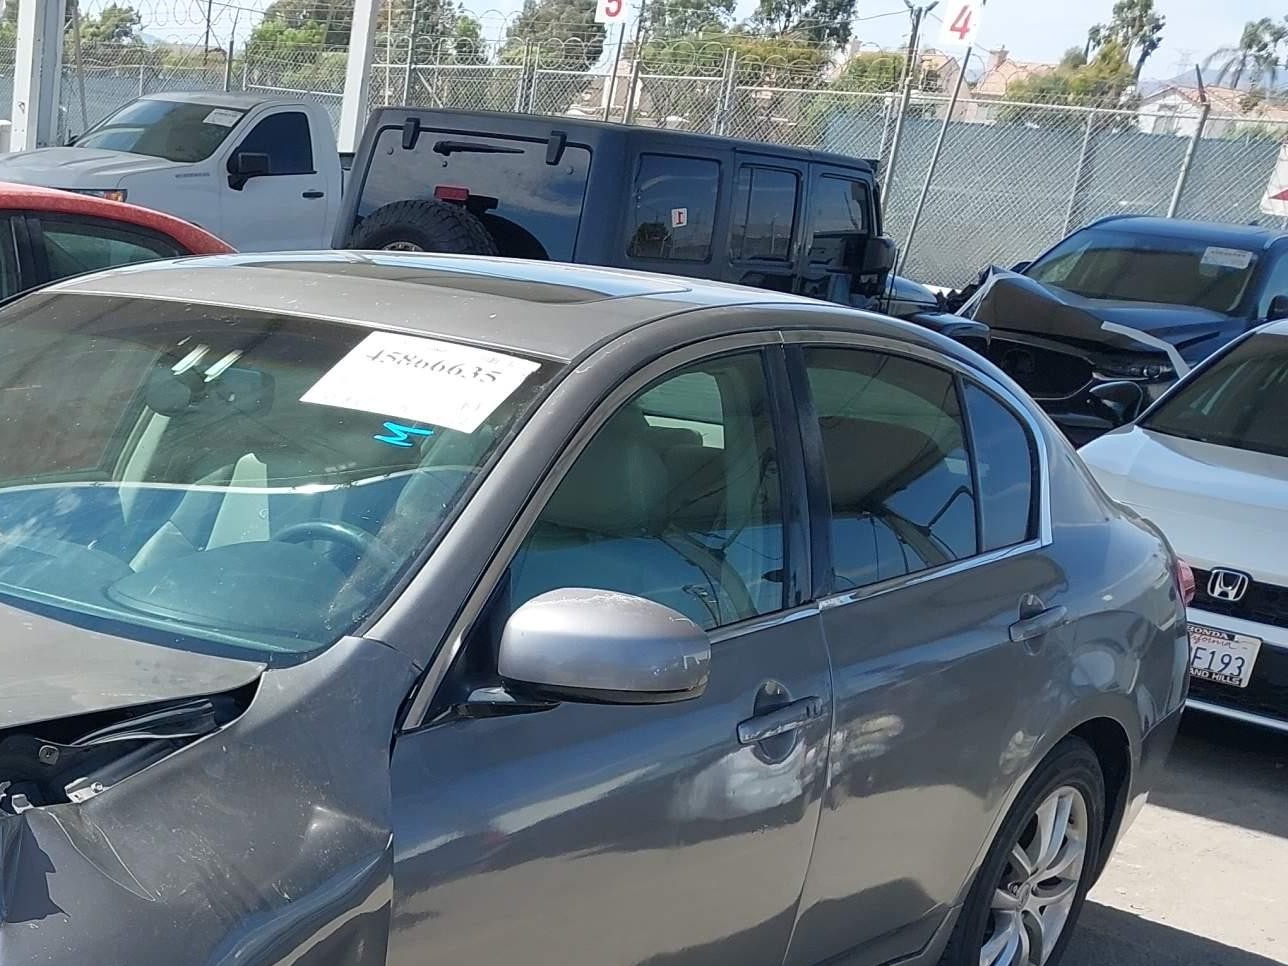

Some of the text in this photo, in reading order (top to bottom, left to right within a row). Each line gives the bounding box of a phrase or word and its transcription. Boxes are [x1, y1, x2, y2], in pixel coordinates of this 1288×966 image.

[950, 4, 972, 40] 4
[365, 349, 503, 383] 45866635
[1192, 646, 1246, 677] F193
